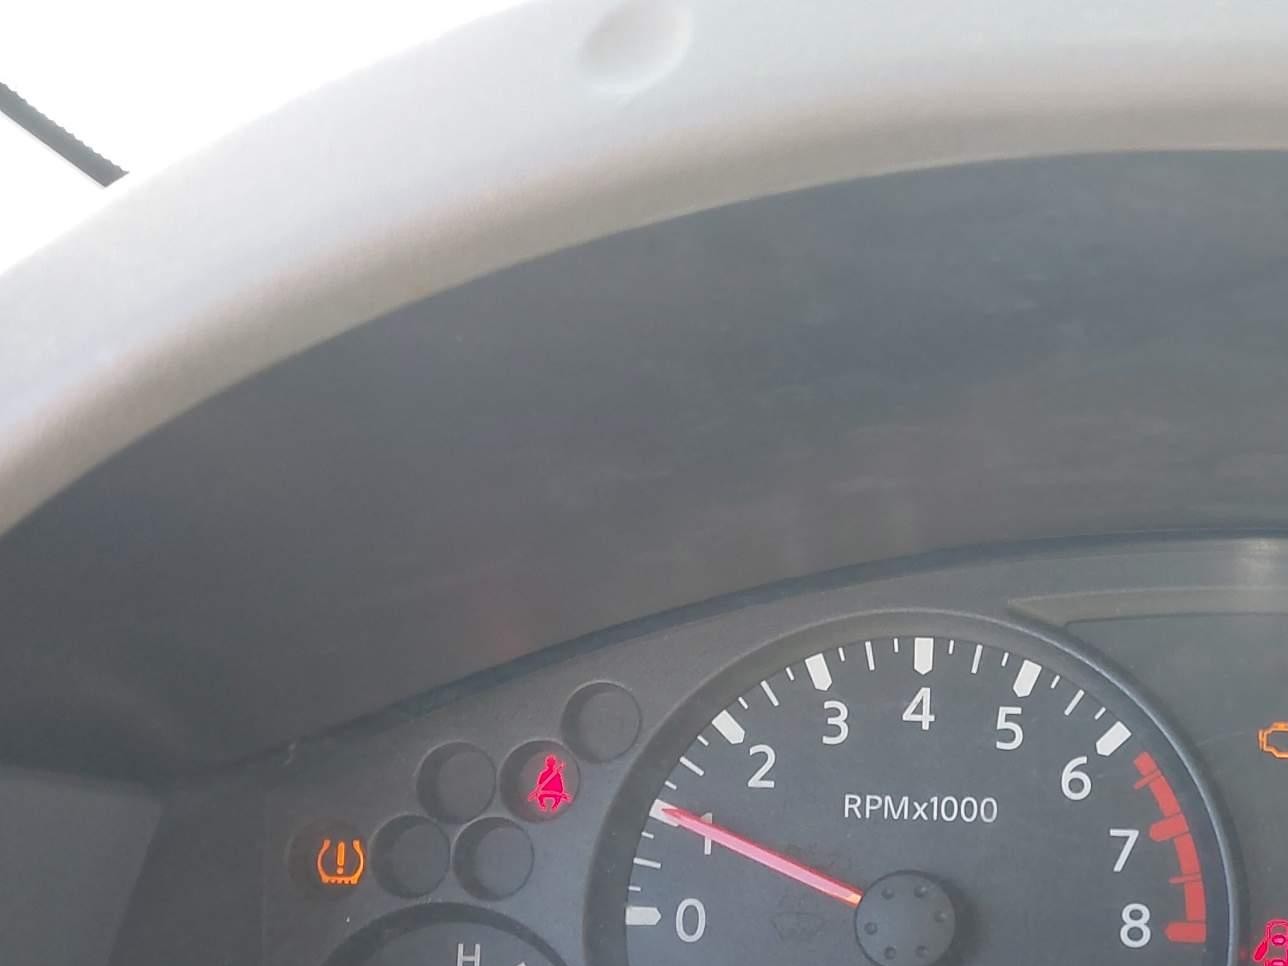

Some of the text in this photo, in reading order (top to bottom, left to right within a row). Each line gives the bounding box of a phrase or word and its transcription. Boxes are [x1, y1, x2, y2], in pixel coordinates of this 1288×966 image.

[823, 701, 848, 744] 3
[903, 688, 934, 730] 4
[997, 707, 1023, 749] 5
[748, 745, 775, 787] 2
[1062, 757, 1091, 800] 6
[845, 795, 997, 822] RPMx1000
[1110, 829, 1139, 871] 7
[676, 899, 705, 942] 0
[1121, 904, 1150, 947] 8
